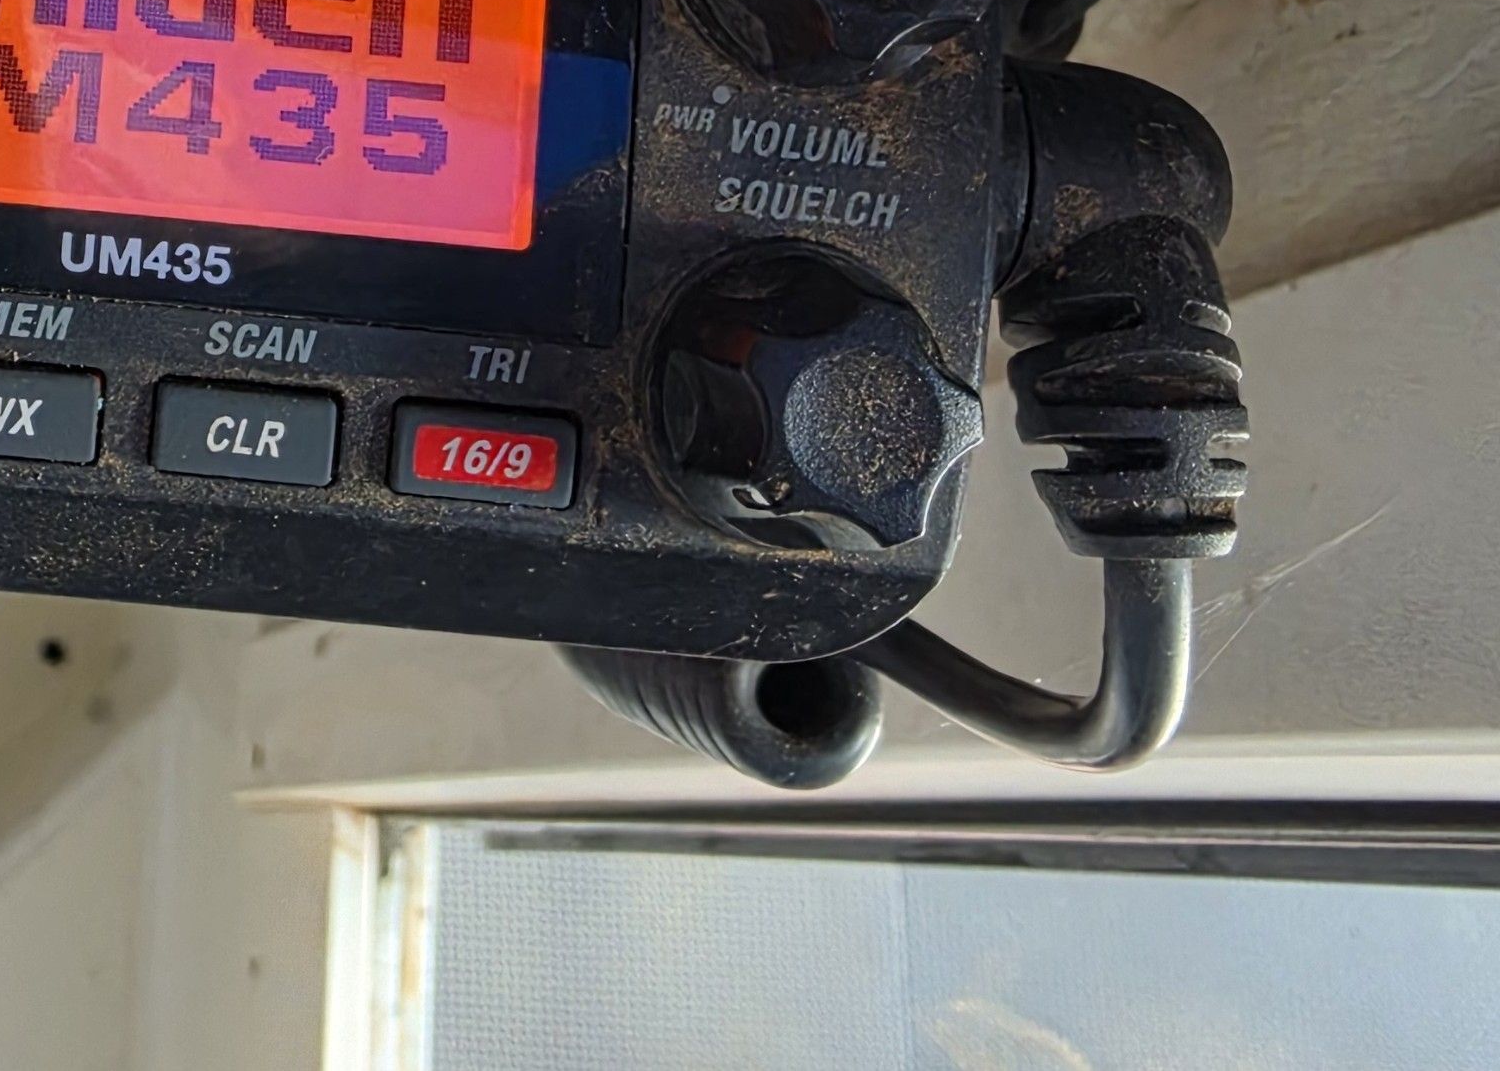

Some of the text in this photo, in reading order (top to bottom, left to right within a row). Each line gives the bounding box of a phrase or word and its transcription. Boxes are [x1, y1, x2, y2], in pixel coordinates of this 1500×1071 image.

[653, 103, 716, 133] PWR
[729, 116, 889, 168] VOLUME
[714, 177, 900, 229] SQUELCH
[60, 231, 233, 286] UM435
[204, 320, 317, 364] SCAN
[468, 345, 531, 385] TRI
[206, 415, 285, 459] CLR
[441, 436, 533, 480] 16/9
